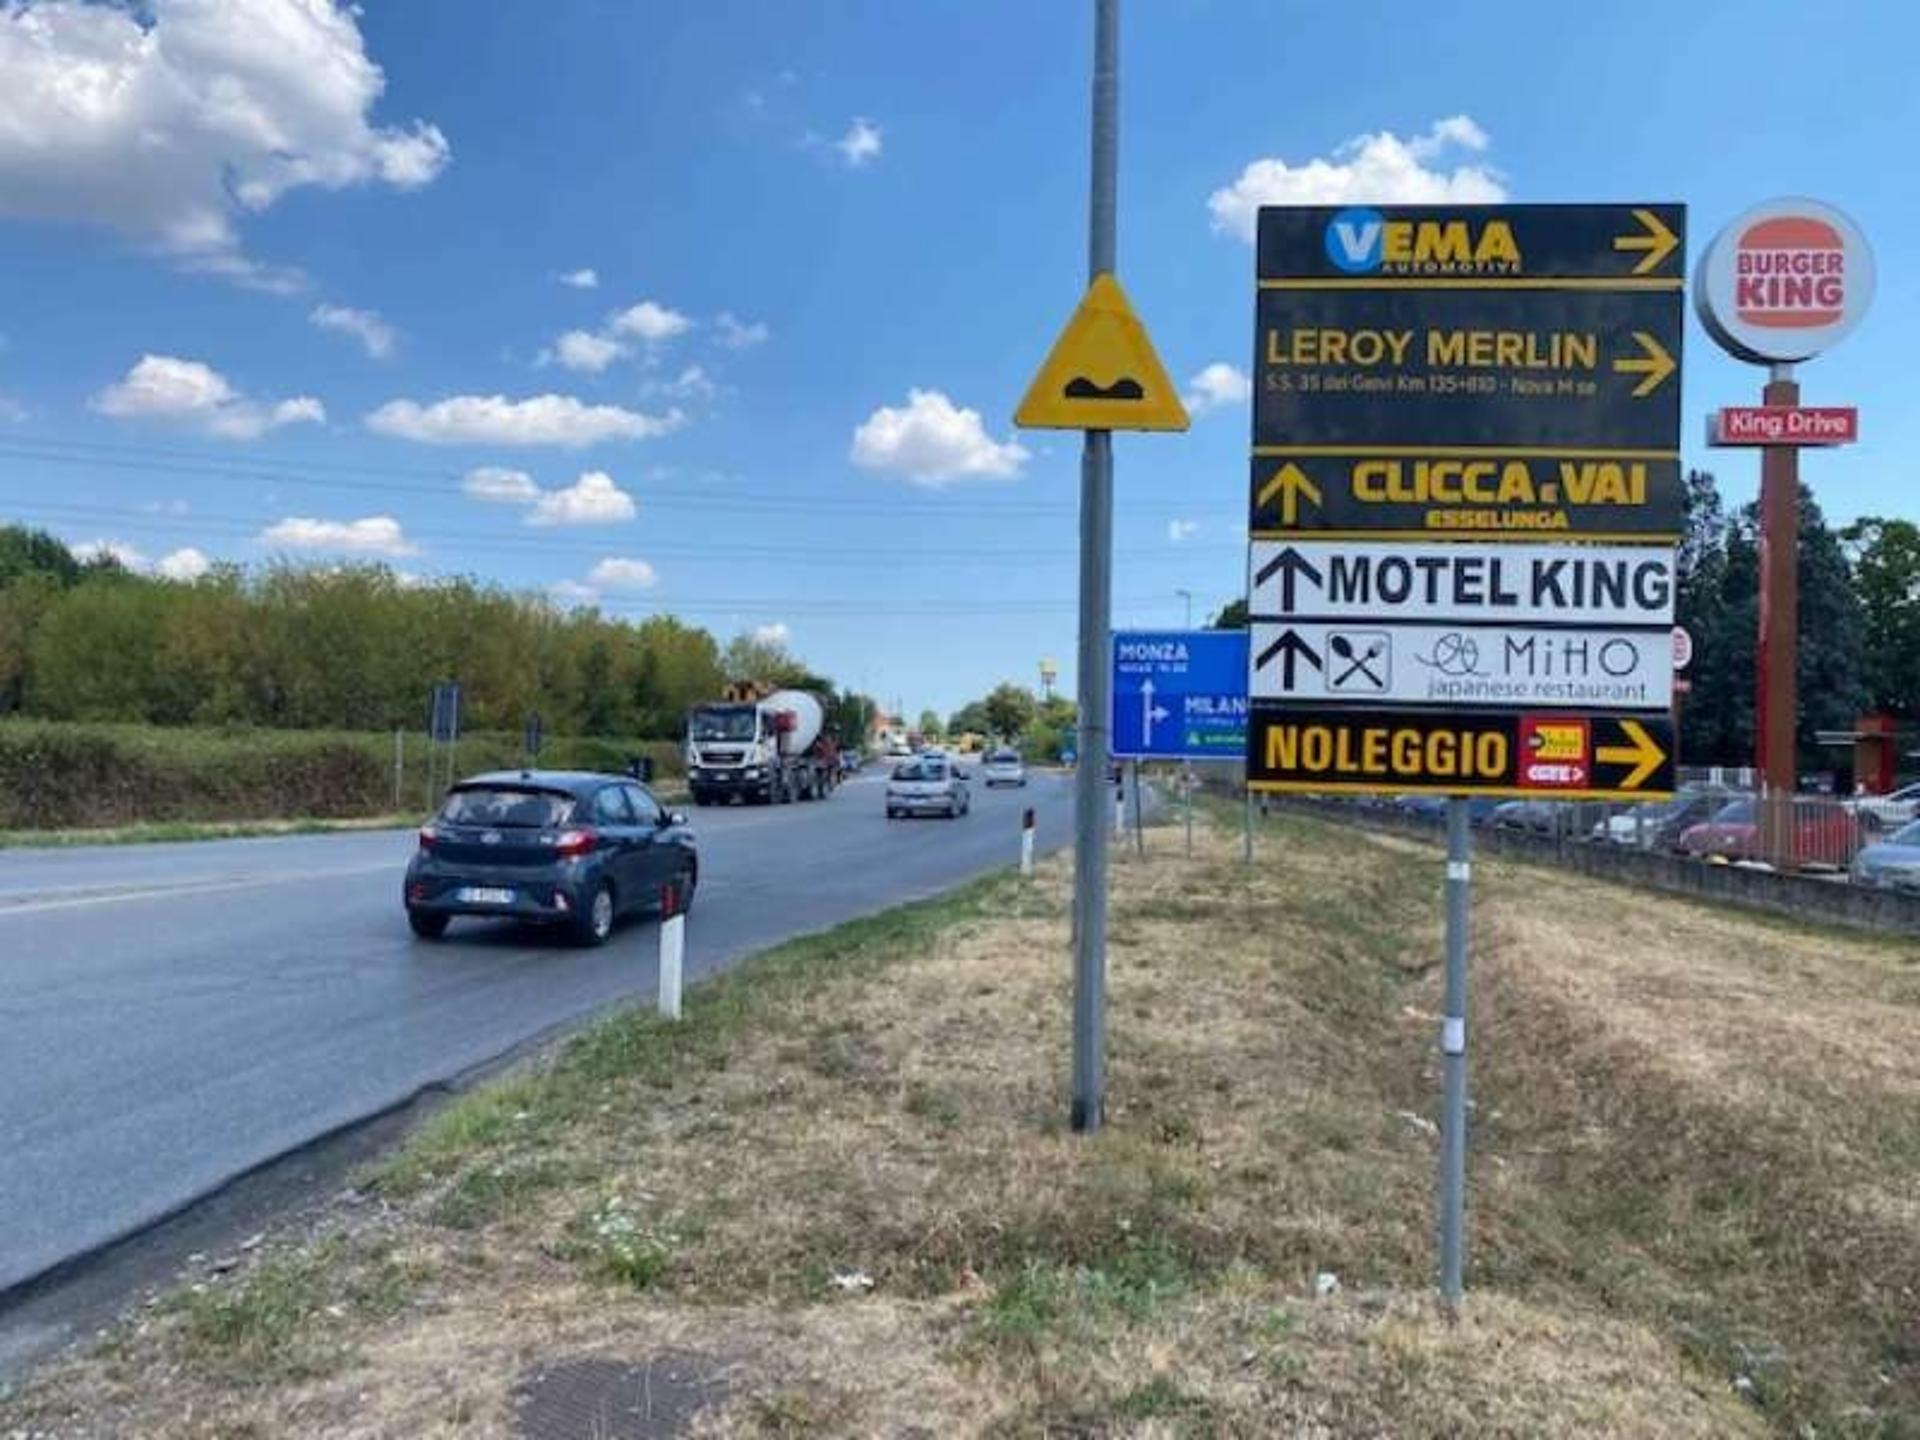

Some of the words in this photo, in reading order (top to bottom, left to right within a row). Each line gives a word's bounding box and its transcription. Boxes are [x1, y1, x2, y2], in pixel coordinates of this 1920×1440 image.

[1335, 220, 1520, 262] VEMA
[1382, 262, 1520, 273] AUTOMOTIVE
[1737, 252, 1843, 274] BURGER
[1738, 277, 1843, 307] KING
[1266, 330, 1413, 365] LEROY
[1428, 332, 1598, 369] MERLIN
[1731, 411, 1783, 436] King
[1787, 410, 1848, 433] Drive
[1352, 461, 1534, 504] CLICCA
[1558, 463, 1647, 505] VAI
[1426, 509, 1570, 528] ESSELUNGA
[1328, 556, 1518, 607] MOTEL
[1532, 560, 1670, 611] KING
[1118, 642, 1189, 661] MONZA
[1504, 635, 1640, 677] MiHO
[1427, 678, 1528, 699] japanese
[1535, 679, 1647, 701] restaurant
[1265, 725, 1508, 777] NOLEGGIO
